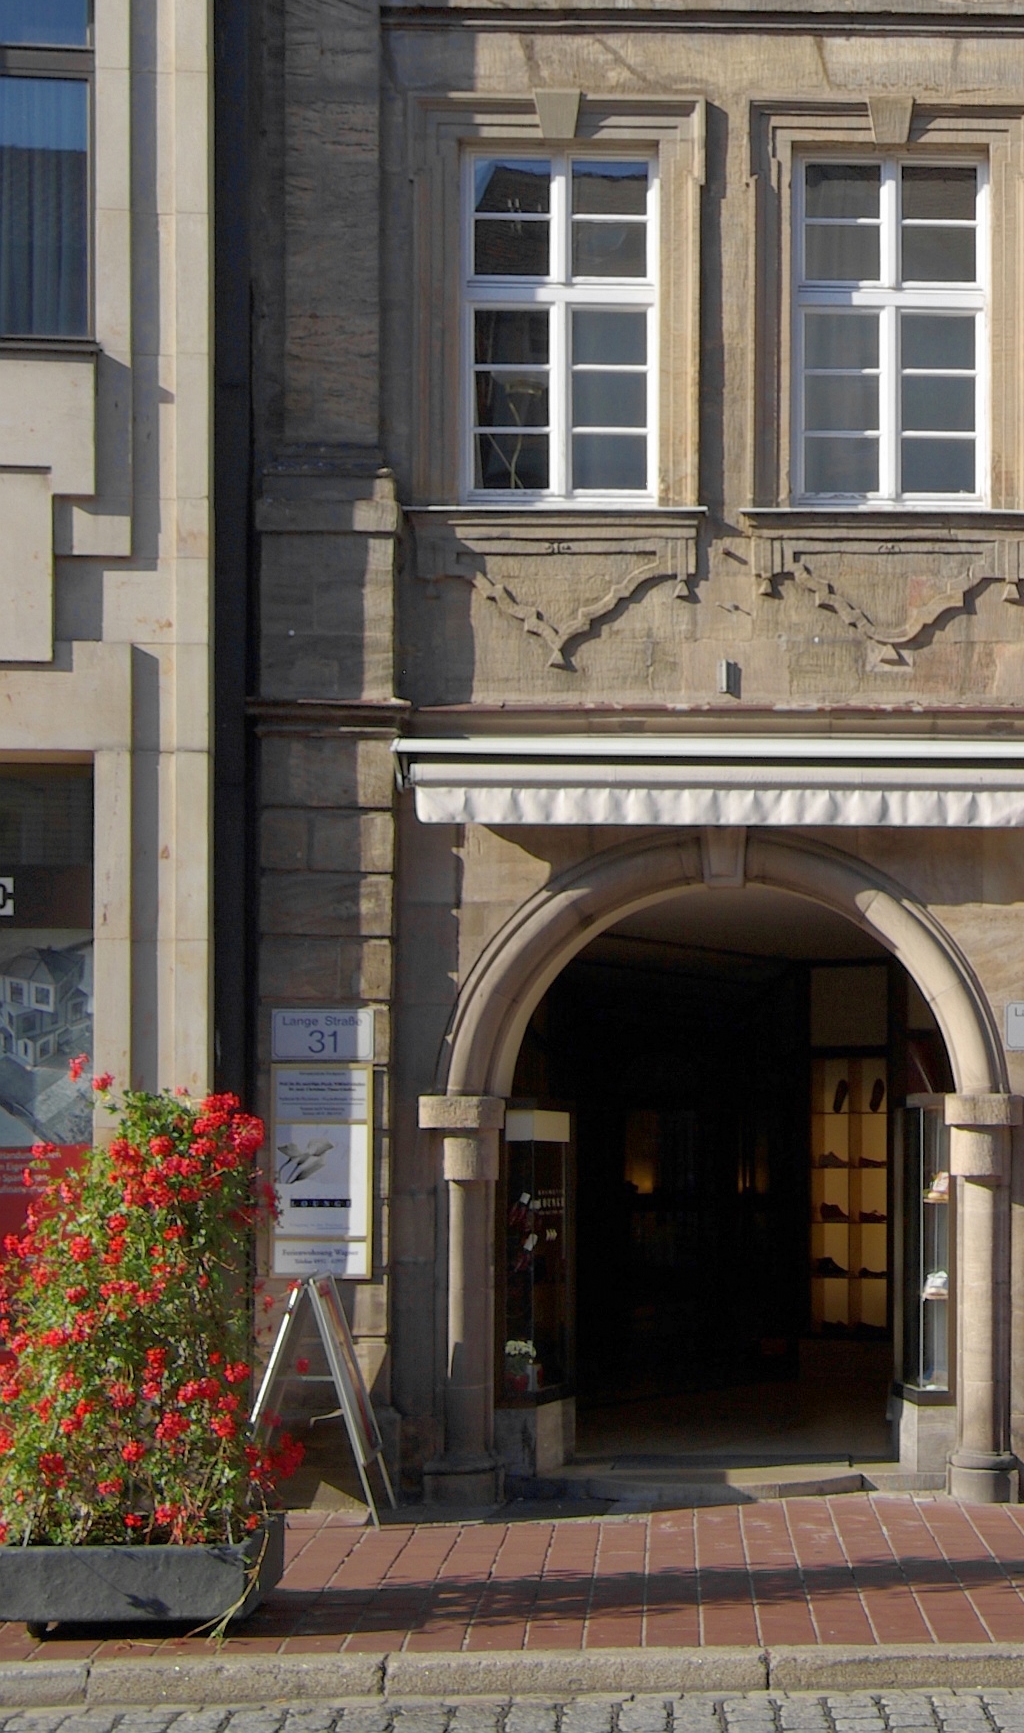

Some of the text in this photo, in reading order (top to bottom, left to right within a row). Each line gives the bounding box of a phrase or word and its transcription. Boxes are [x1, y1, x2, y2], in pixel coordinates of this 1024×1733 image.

[282, 1015, 363, 1028] Lange Straße
[308, 1030, 338, 1054] 31
